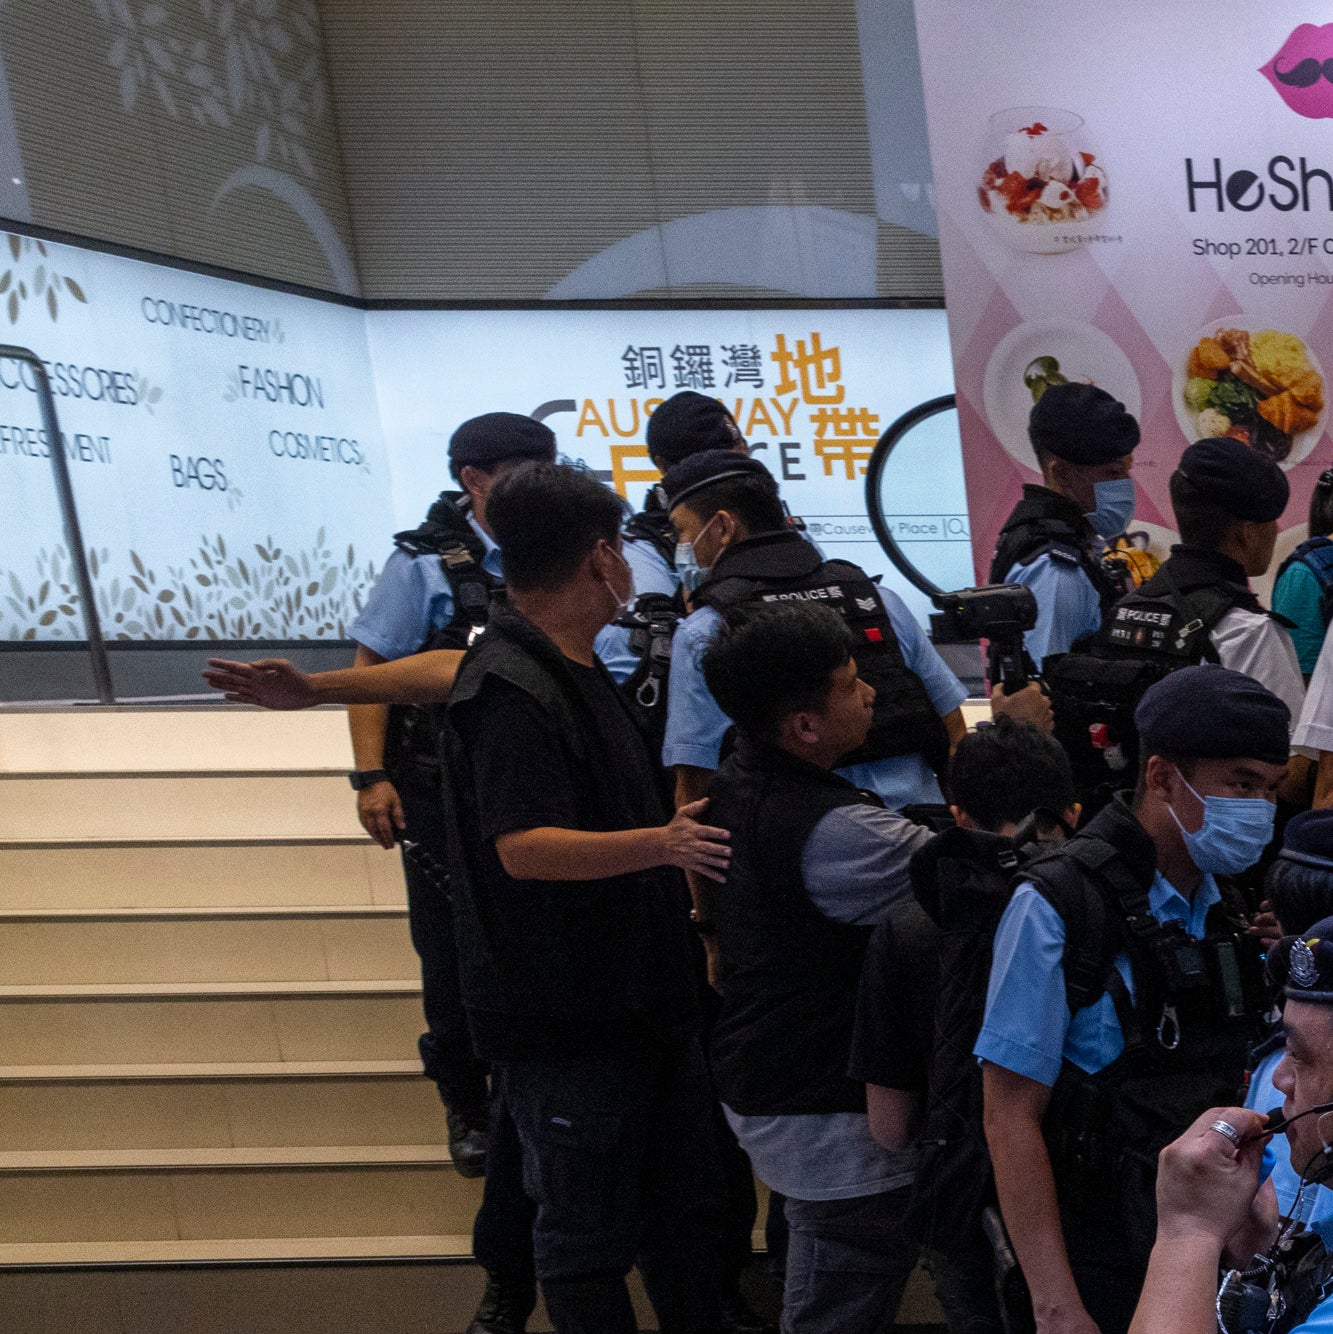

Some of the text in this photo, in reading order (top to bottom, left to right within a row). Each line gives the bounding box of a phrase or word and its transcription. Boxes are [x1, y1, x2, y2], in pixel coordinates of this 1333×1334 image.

[1192, 238, 1242, 259] Shop
[1245, 238, 1284, 257] 201,
[1288, 237, 1319, 256] 2/F
[1250, 272, 1305, 287] Opening
[141, 296, 270, 343] CONFECTIONERY
[238, 364, 325, 409] FASHION
[269, 430, 364, 465] COSMETICS
[169, 454, 228, 492] BAGS
[898, 521, 938, 534] Place
